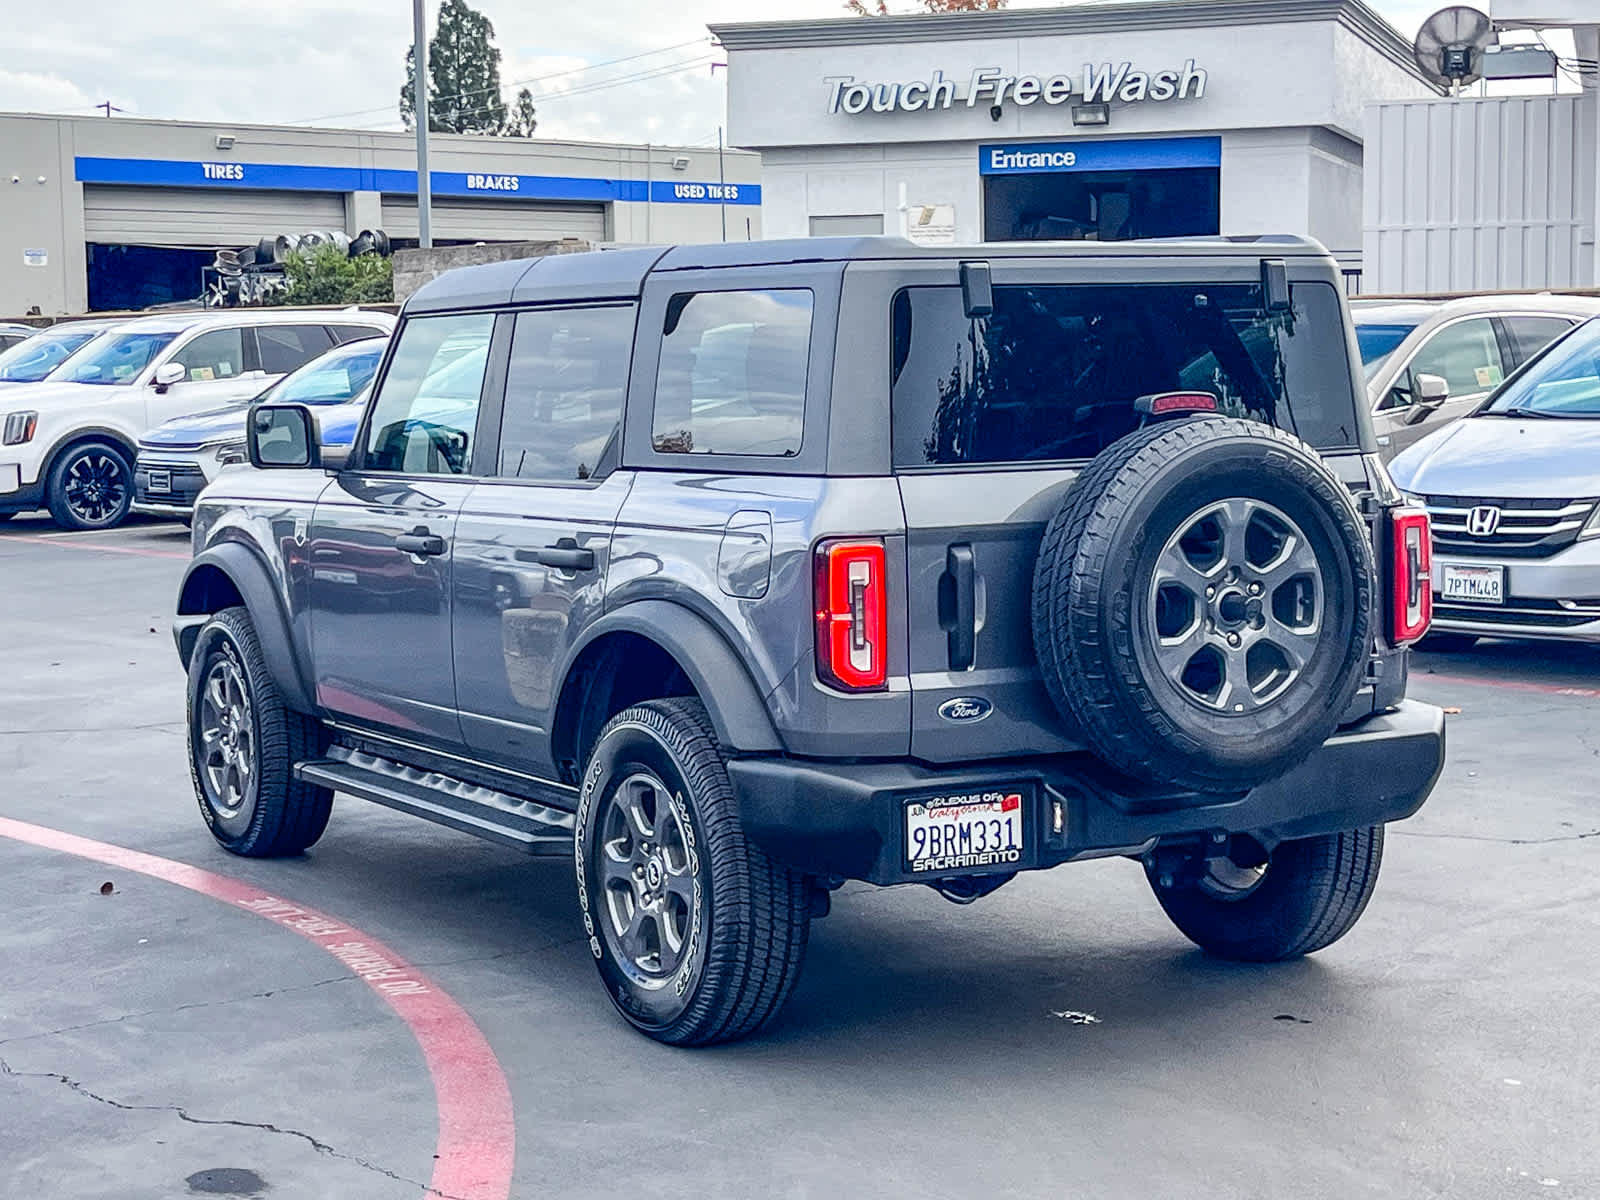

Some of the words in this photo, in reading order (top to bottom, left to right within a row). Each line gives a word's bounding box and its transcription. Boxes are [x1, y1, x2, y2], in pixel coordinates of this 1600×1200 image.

[822, 70, 955, 114] Touch
[967, 66, 1072, 107] Free
[1082, 58, 1208, 102] Wash
[991, 149, 1076, 168] Entrance
[202, 163, 244, 180] TIRES
[467, 174, 519, 190] BRAKES
[674, 184, 706, 198] USED
[951, 702, 980, 718] Ford
[940, 795, 981, 807] LEXUS
[913, 817, 1016, 860] 9BRM331
[912, 849, 1020, 872] SACRAMENTO
[377, 980, 432, 996] NO
